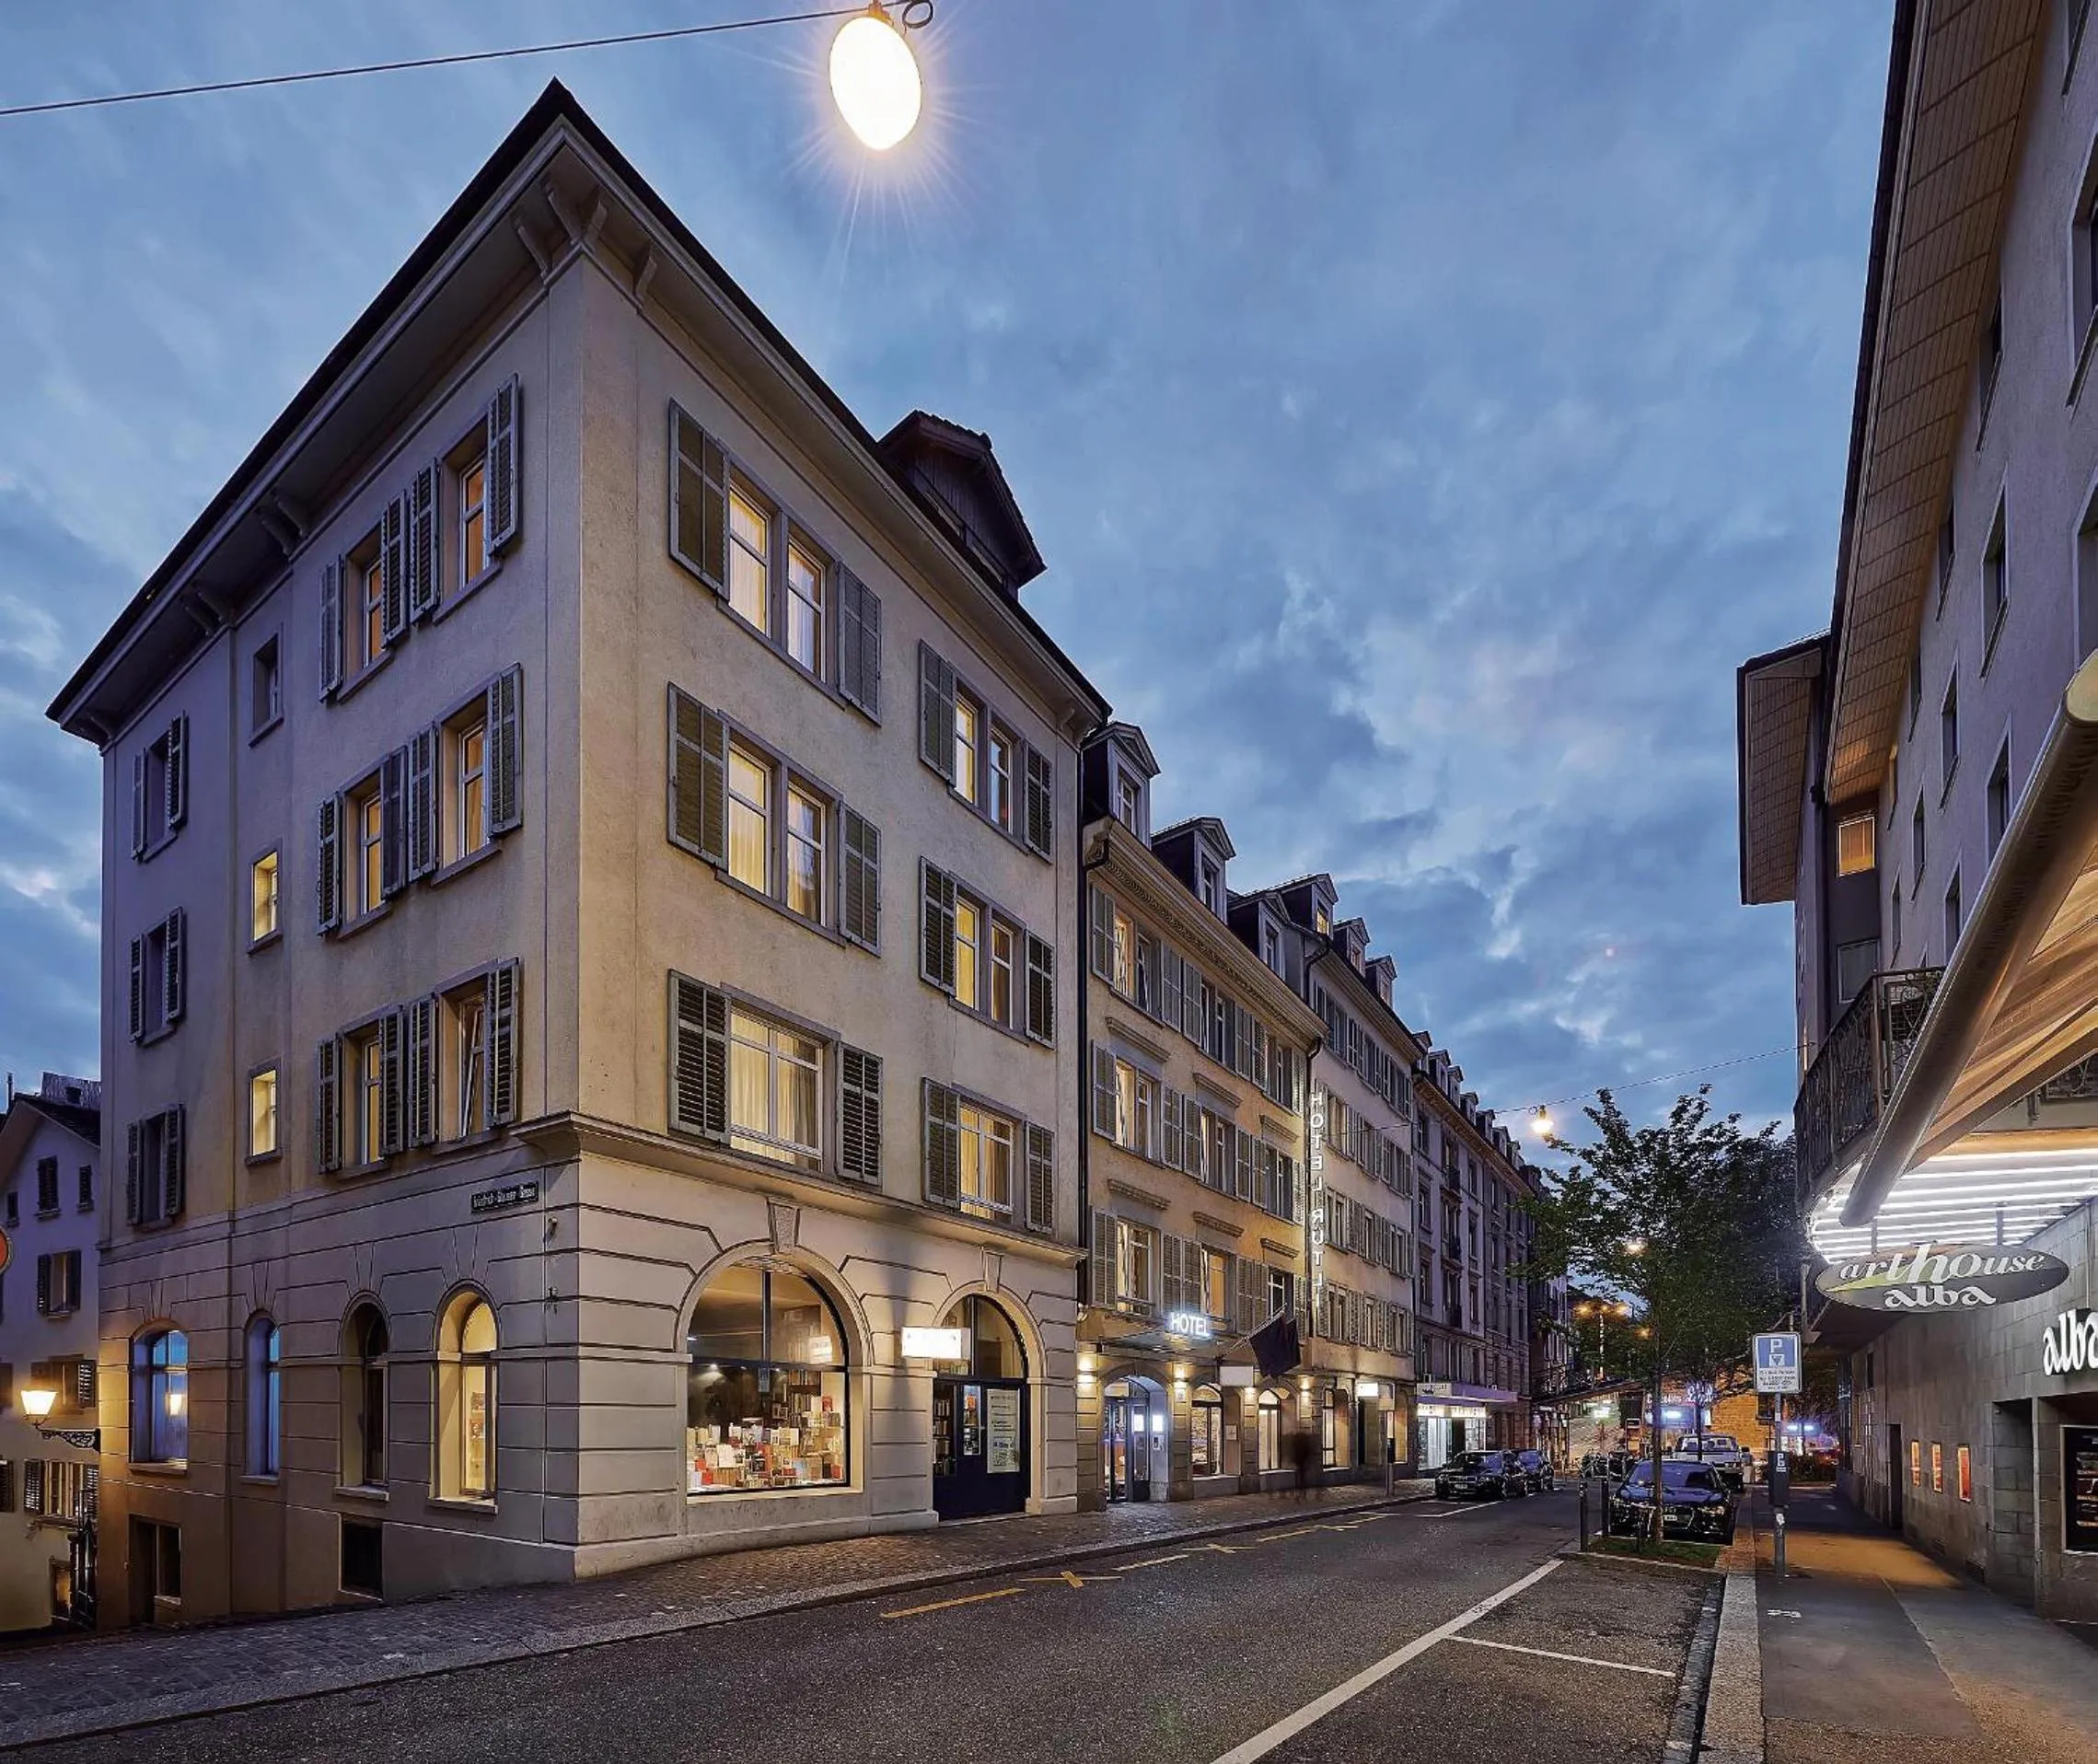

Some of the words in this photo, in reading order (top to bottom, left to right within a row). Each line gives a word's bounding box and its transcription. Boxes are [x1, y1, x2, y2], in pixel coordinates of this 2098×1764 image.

[1839, 1243, 2046, 1284] arthouse
[1884, 1284, 1997, 1308] alba
[1170, 1312, 1211, 1337] HOTEL
[1769, 1338, 1783, 1353] P
